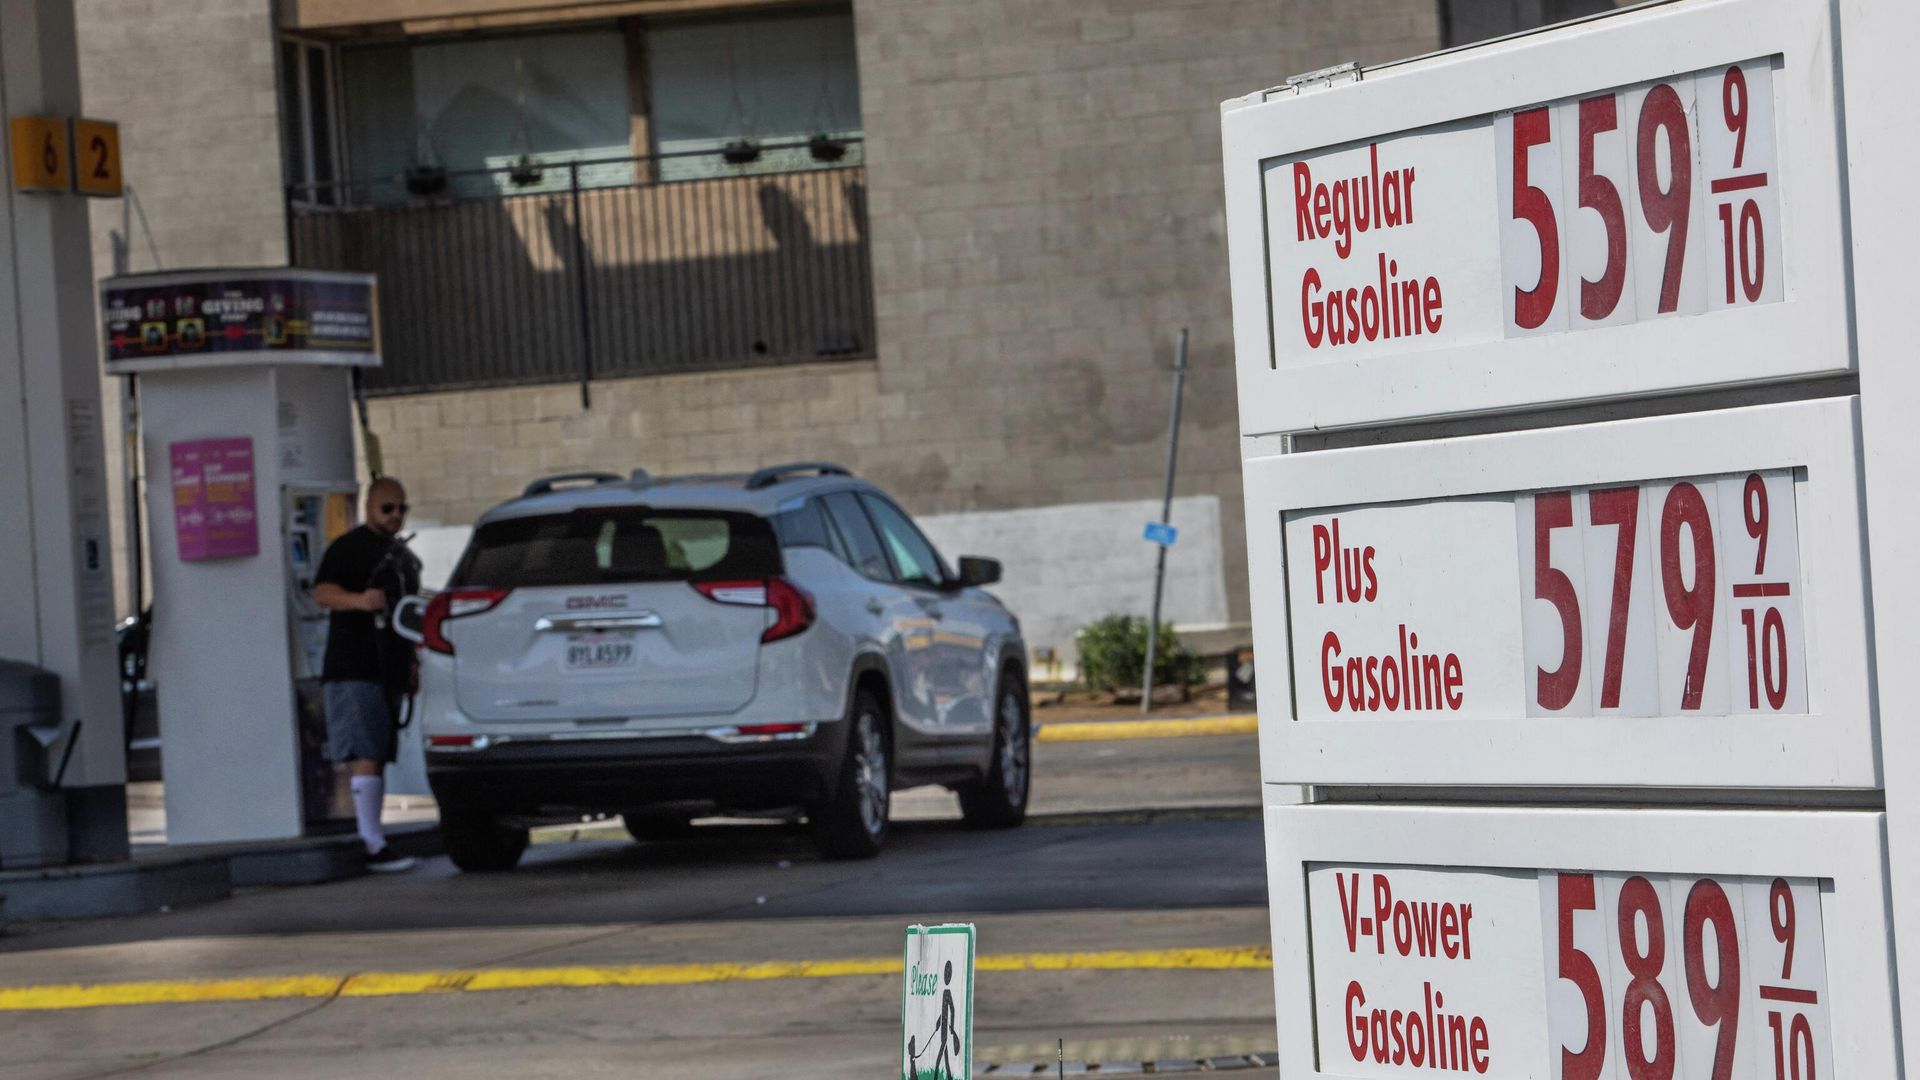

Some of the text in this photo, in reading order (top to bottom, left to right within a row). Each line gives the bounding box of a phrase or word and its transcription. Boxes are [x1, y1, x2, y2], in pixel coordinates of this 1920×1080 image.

[44, 131, 58, 176] 6
[90, 135, 110, 179] 2
[1723, 65, 1748, 169] 9
[1293, 142, 1416, 260] Regular
[1512, 84, 1692, 330] 559
[1718, 198, 1764, 304] 10
[1302, 252, 1444, 349] Gasoline
[1312, 518, 1378, 604] Plus
[1743, 473, 1769, 575] 9
[565, 593, 628, 611] GMC
[1534, 481, 1716, 711] 579
[1321, 624, 1464, 713] Gasoline
[1741, 606, 1788, 711] 10
[1335, 872, 1473, 960] V-Power
[1769, 877, 1796, 980] 9
[911, 961, 938, 996] Please
[1557, 871, 1741, 1080] 589
[1345, 980, 1490, 1074] Gasoline
[1768, 1010, 1816, 1080] 10
